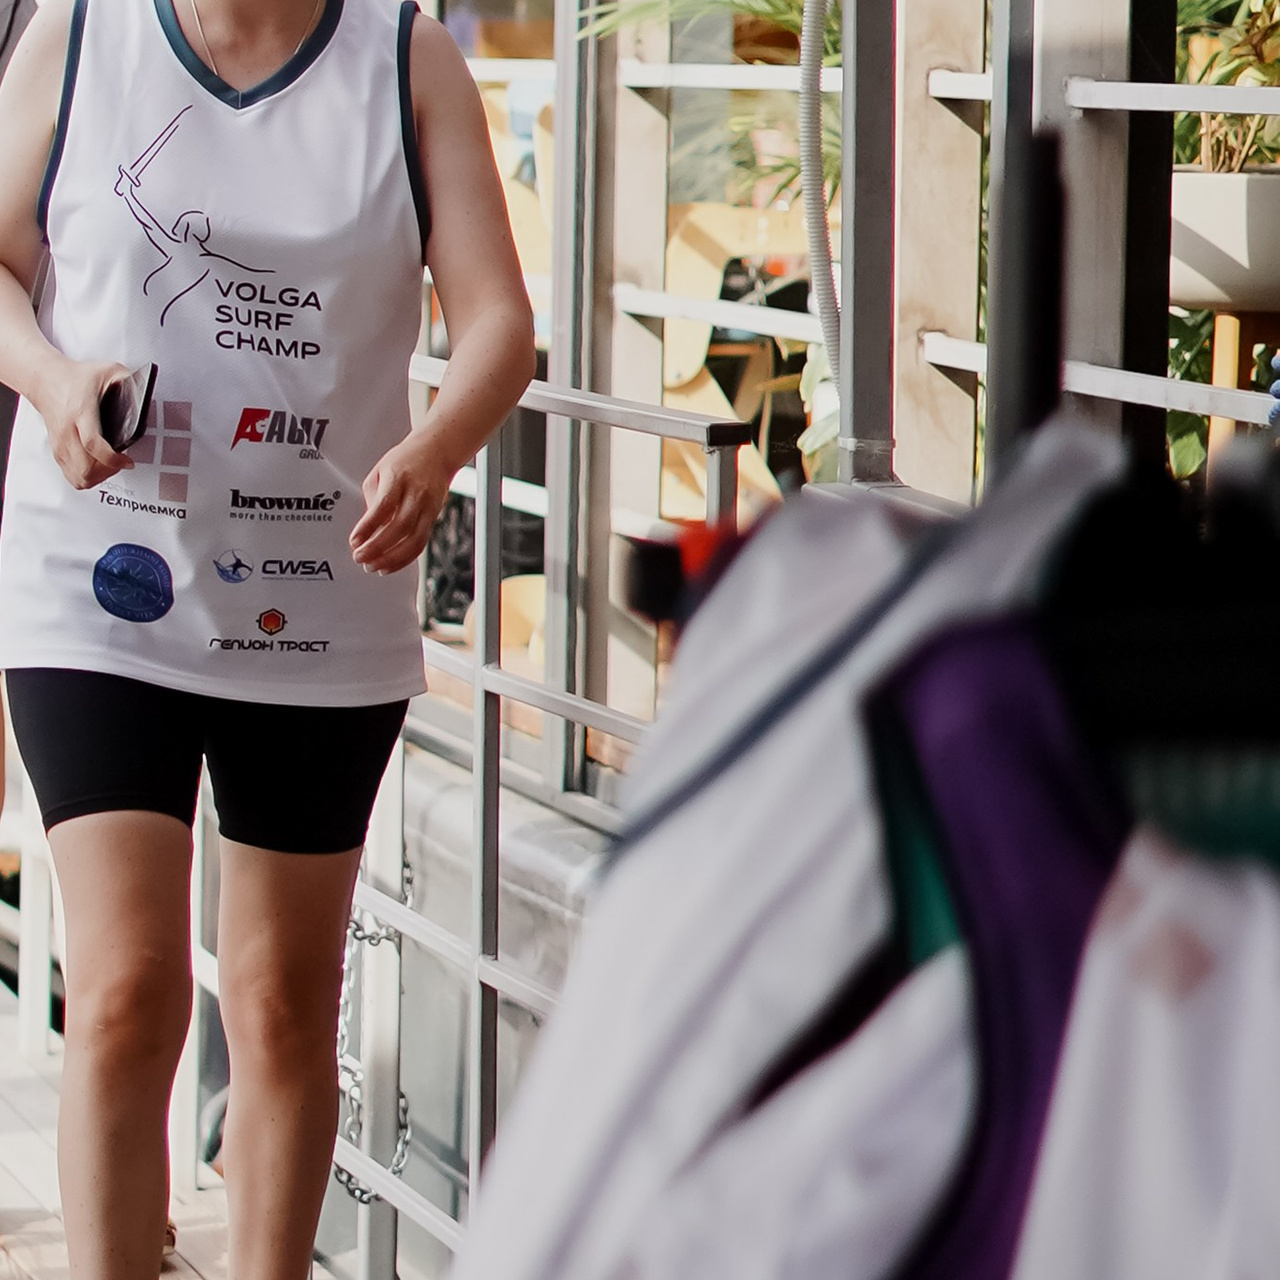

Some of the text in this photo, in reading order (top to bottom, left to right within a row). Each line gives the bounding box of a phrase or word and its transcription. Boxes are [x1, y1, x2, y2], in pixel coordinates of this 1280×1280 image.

[215, 279, 322, 311] VOLGA
[215, 304, 294, 331] SURF
[215, 330, 321, 359] CHAMP
[99, 490, 187, 519] Техприемка
[229, 512, 255, 520] more
[259, 513, 282, 521] than
[262, 560, 334, 581] CWSA
